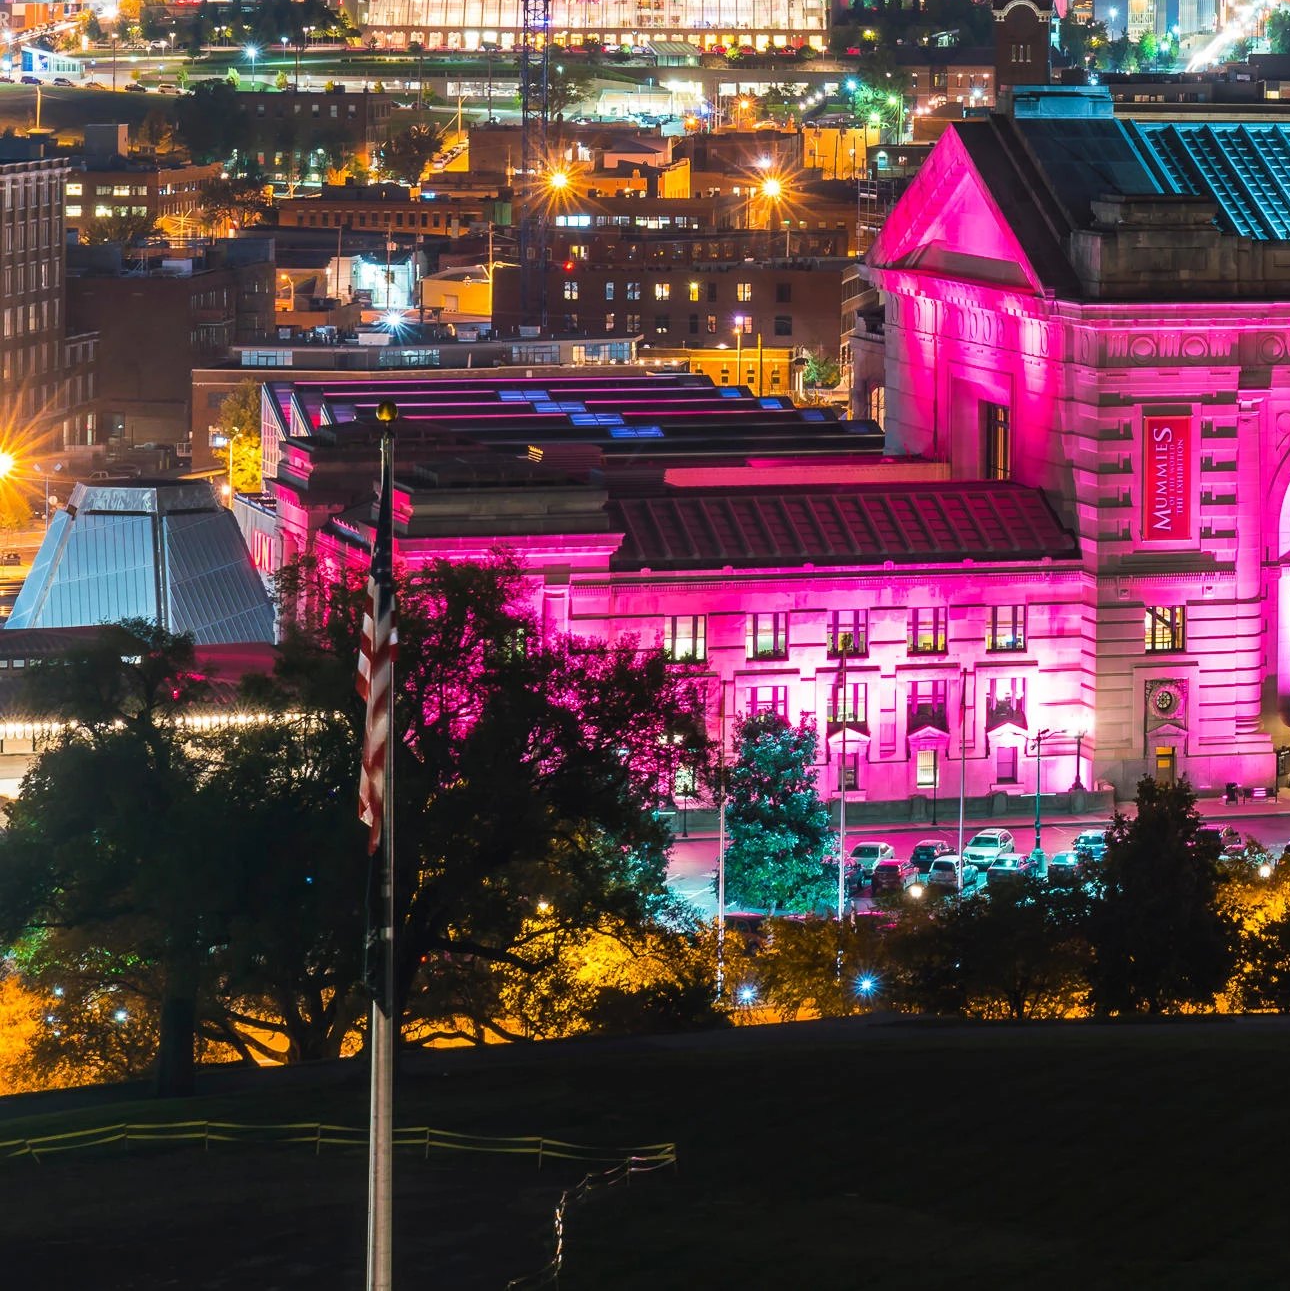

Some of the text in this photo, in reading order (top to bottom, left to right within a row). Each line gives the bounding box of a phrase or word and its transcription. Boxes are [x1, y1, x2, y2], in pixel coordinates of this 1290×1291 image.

[1152, 427, 1173, 531] MUMMIES
[1176, 438, 1184, 514] THE EXHIBITION
